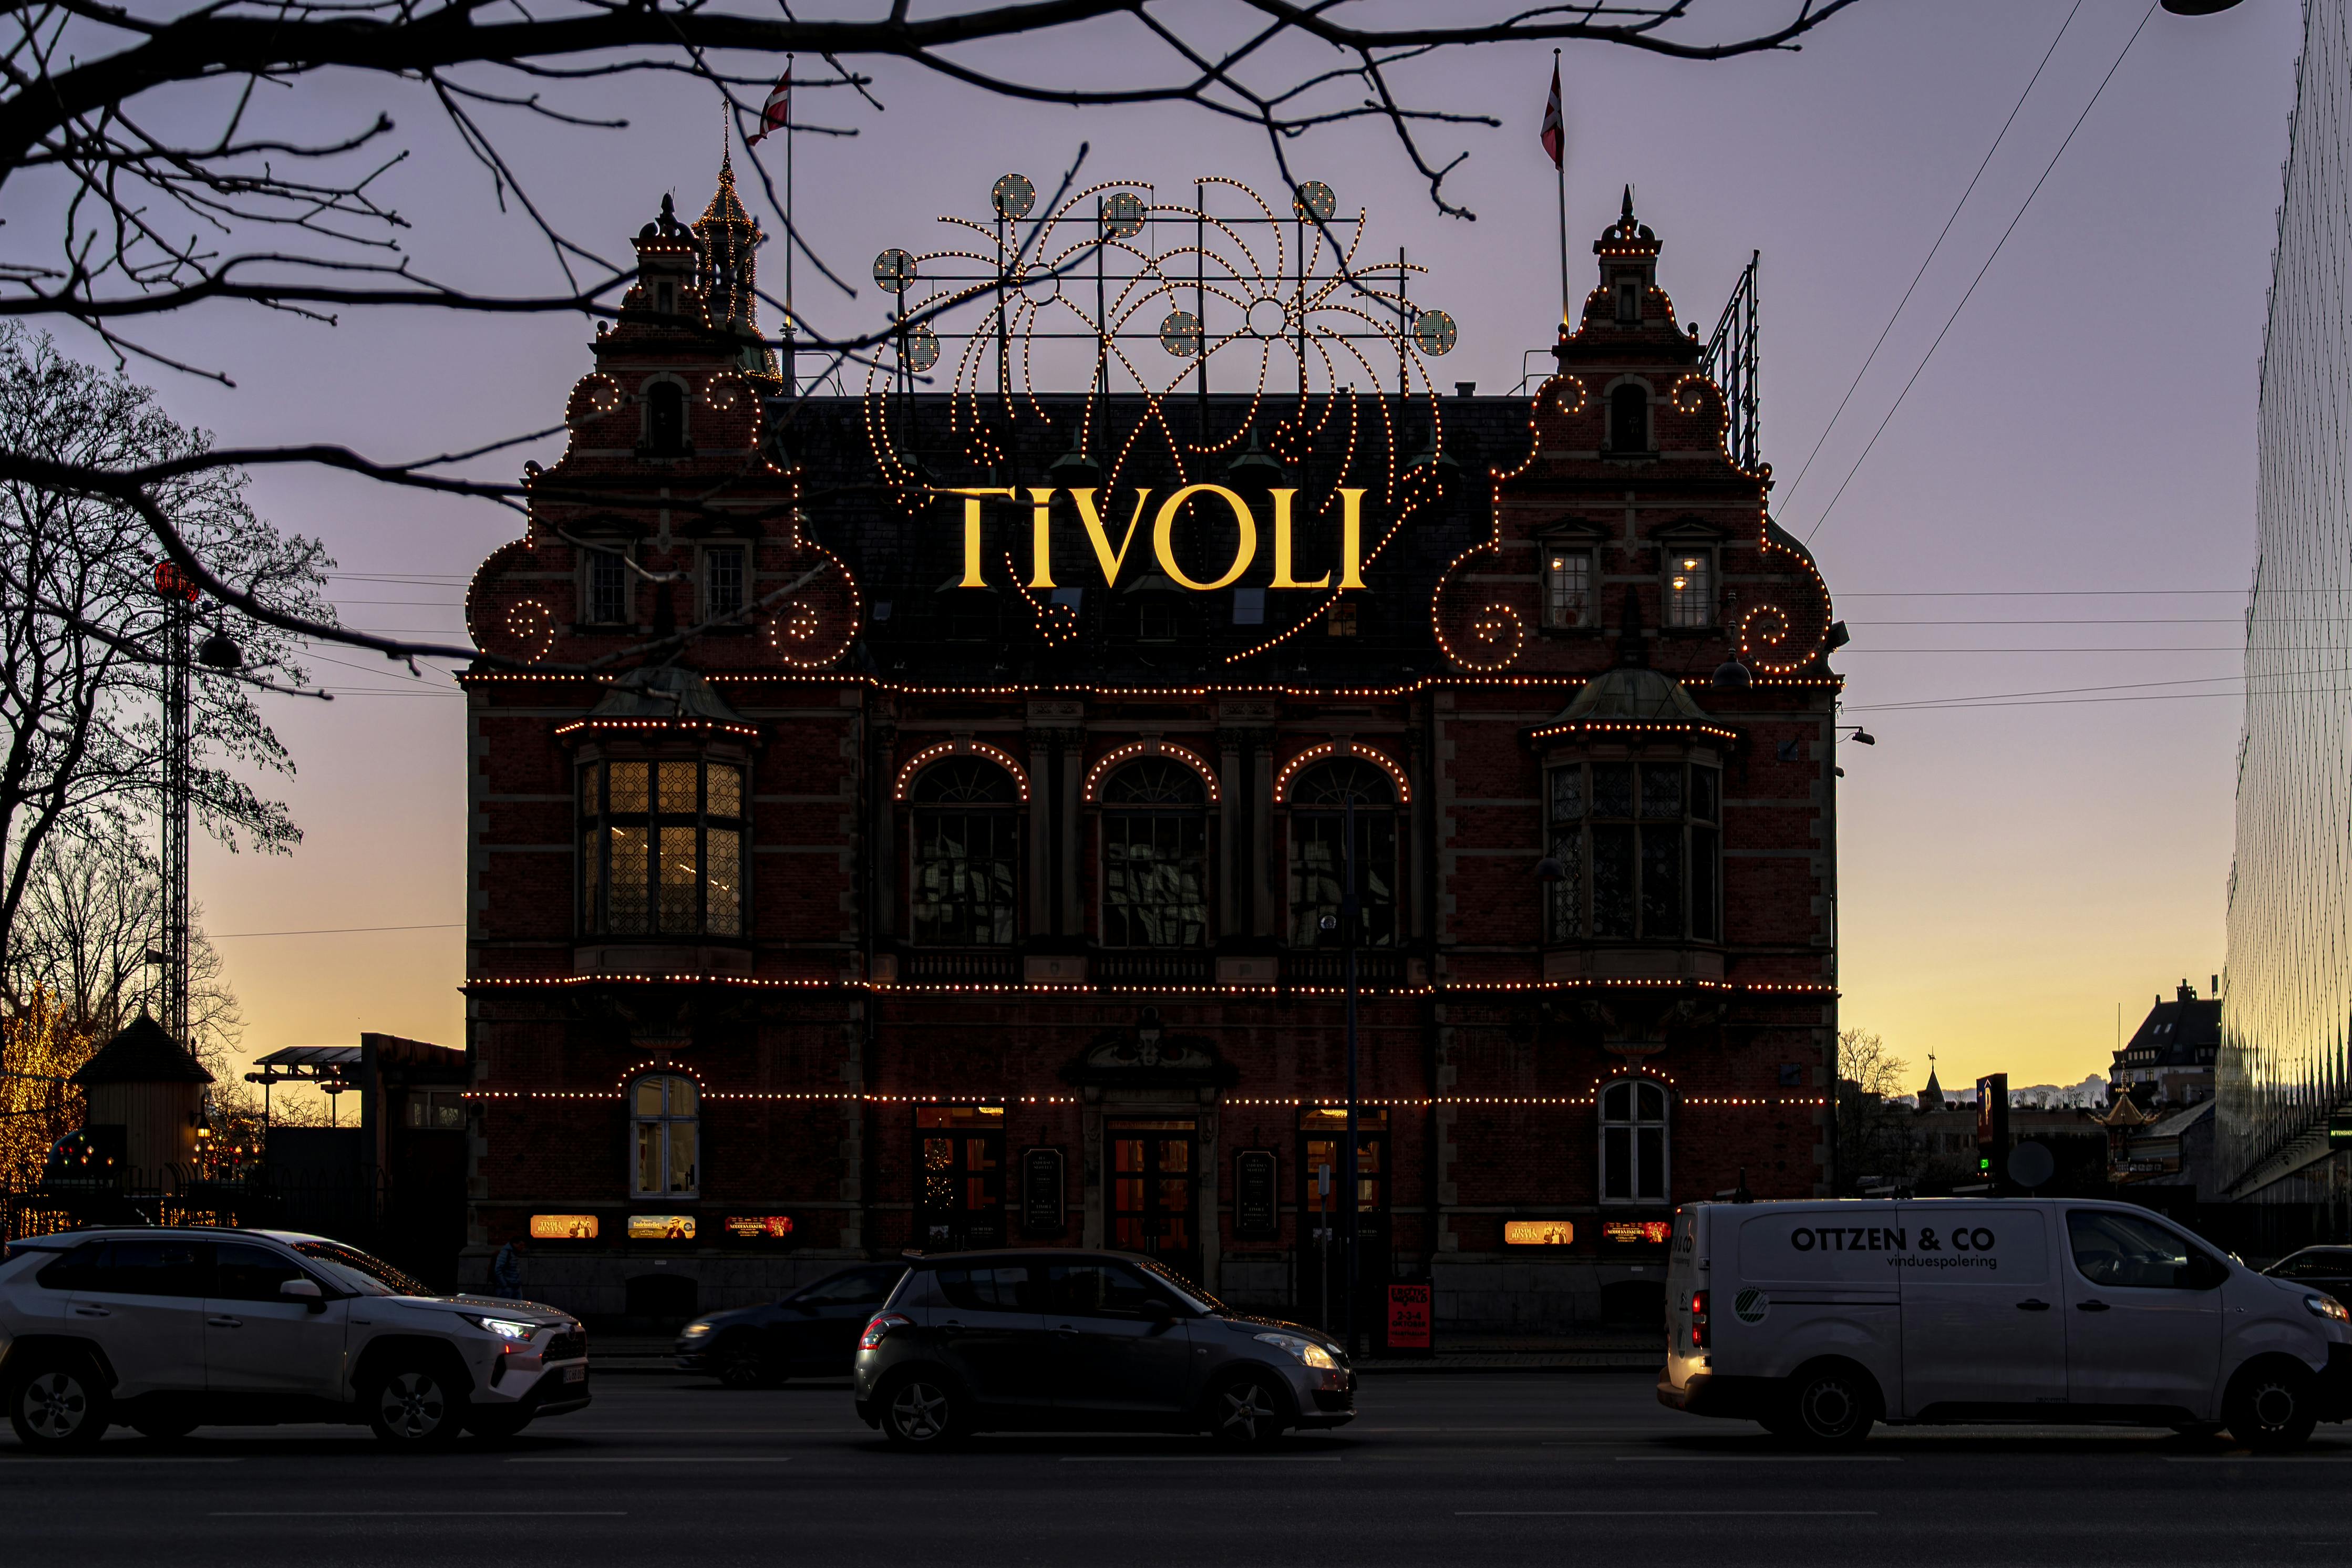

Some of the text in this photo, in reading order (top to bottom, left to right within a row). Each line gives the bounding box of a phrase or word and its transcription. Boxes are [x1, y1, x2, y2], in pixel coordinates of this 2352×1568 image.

[930, 483, 1368, 590] TIVOLI
[1791, 1227, 1995, 1251] OTTZEN & CO
[1886, 1254, 1997, 1270] vinduespolering
